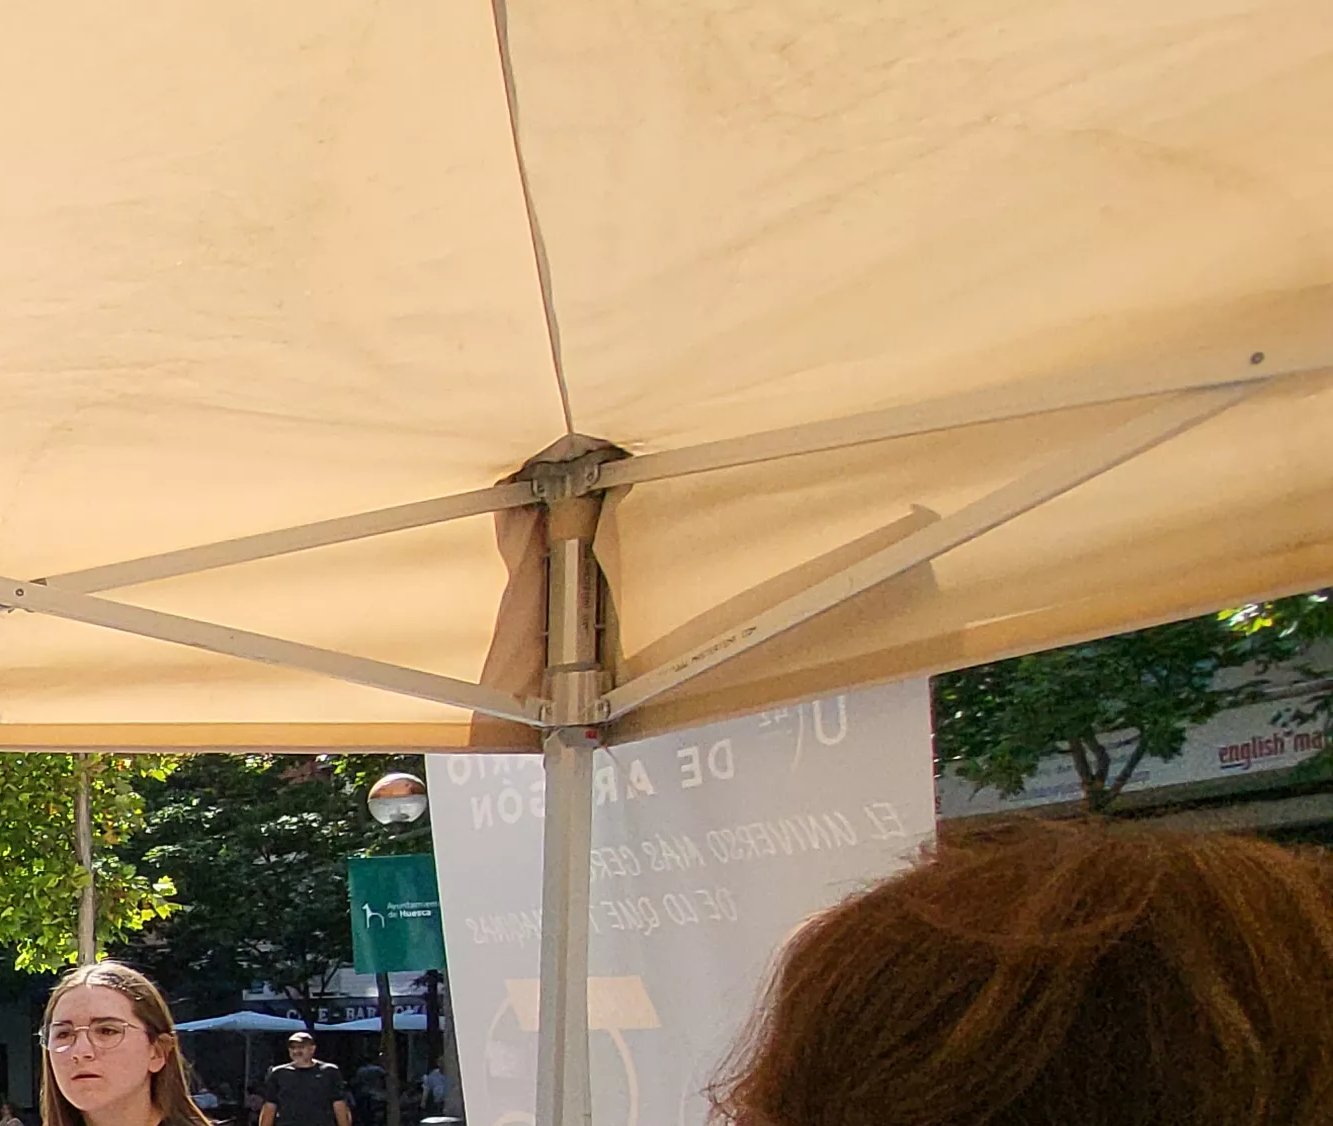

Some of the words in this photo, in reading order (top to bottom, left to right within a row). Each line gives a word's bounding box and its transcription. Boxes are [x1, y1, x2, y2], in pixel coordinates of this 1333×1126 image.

[1219, 733, 1285, 769] english
[386, 901, 439, 911] Ayuntamient
[387, 910, 398, 919] de
[399, 908, 432, 918] Huesca
[345, 1007, 378, 1021] BAR
